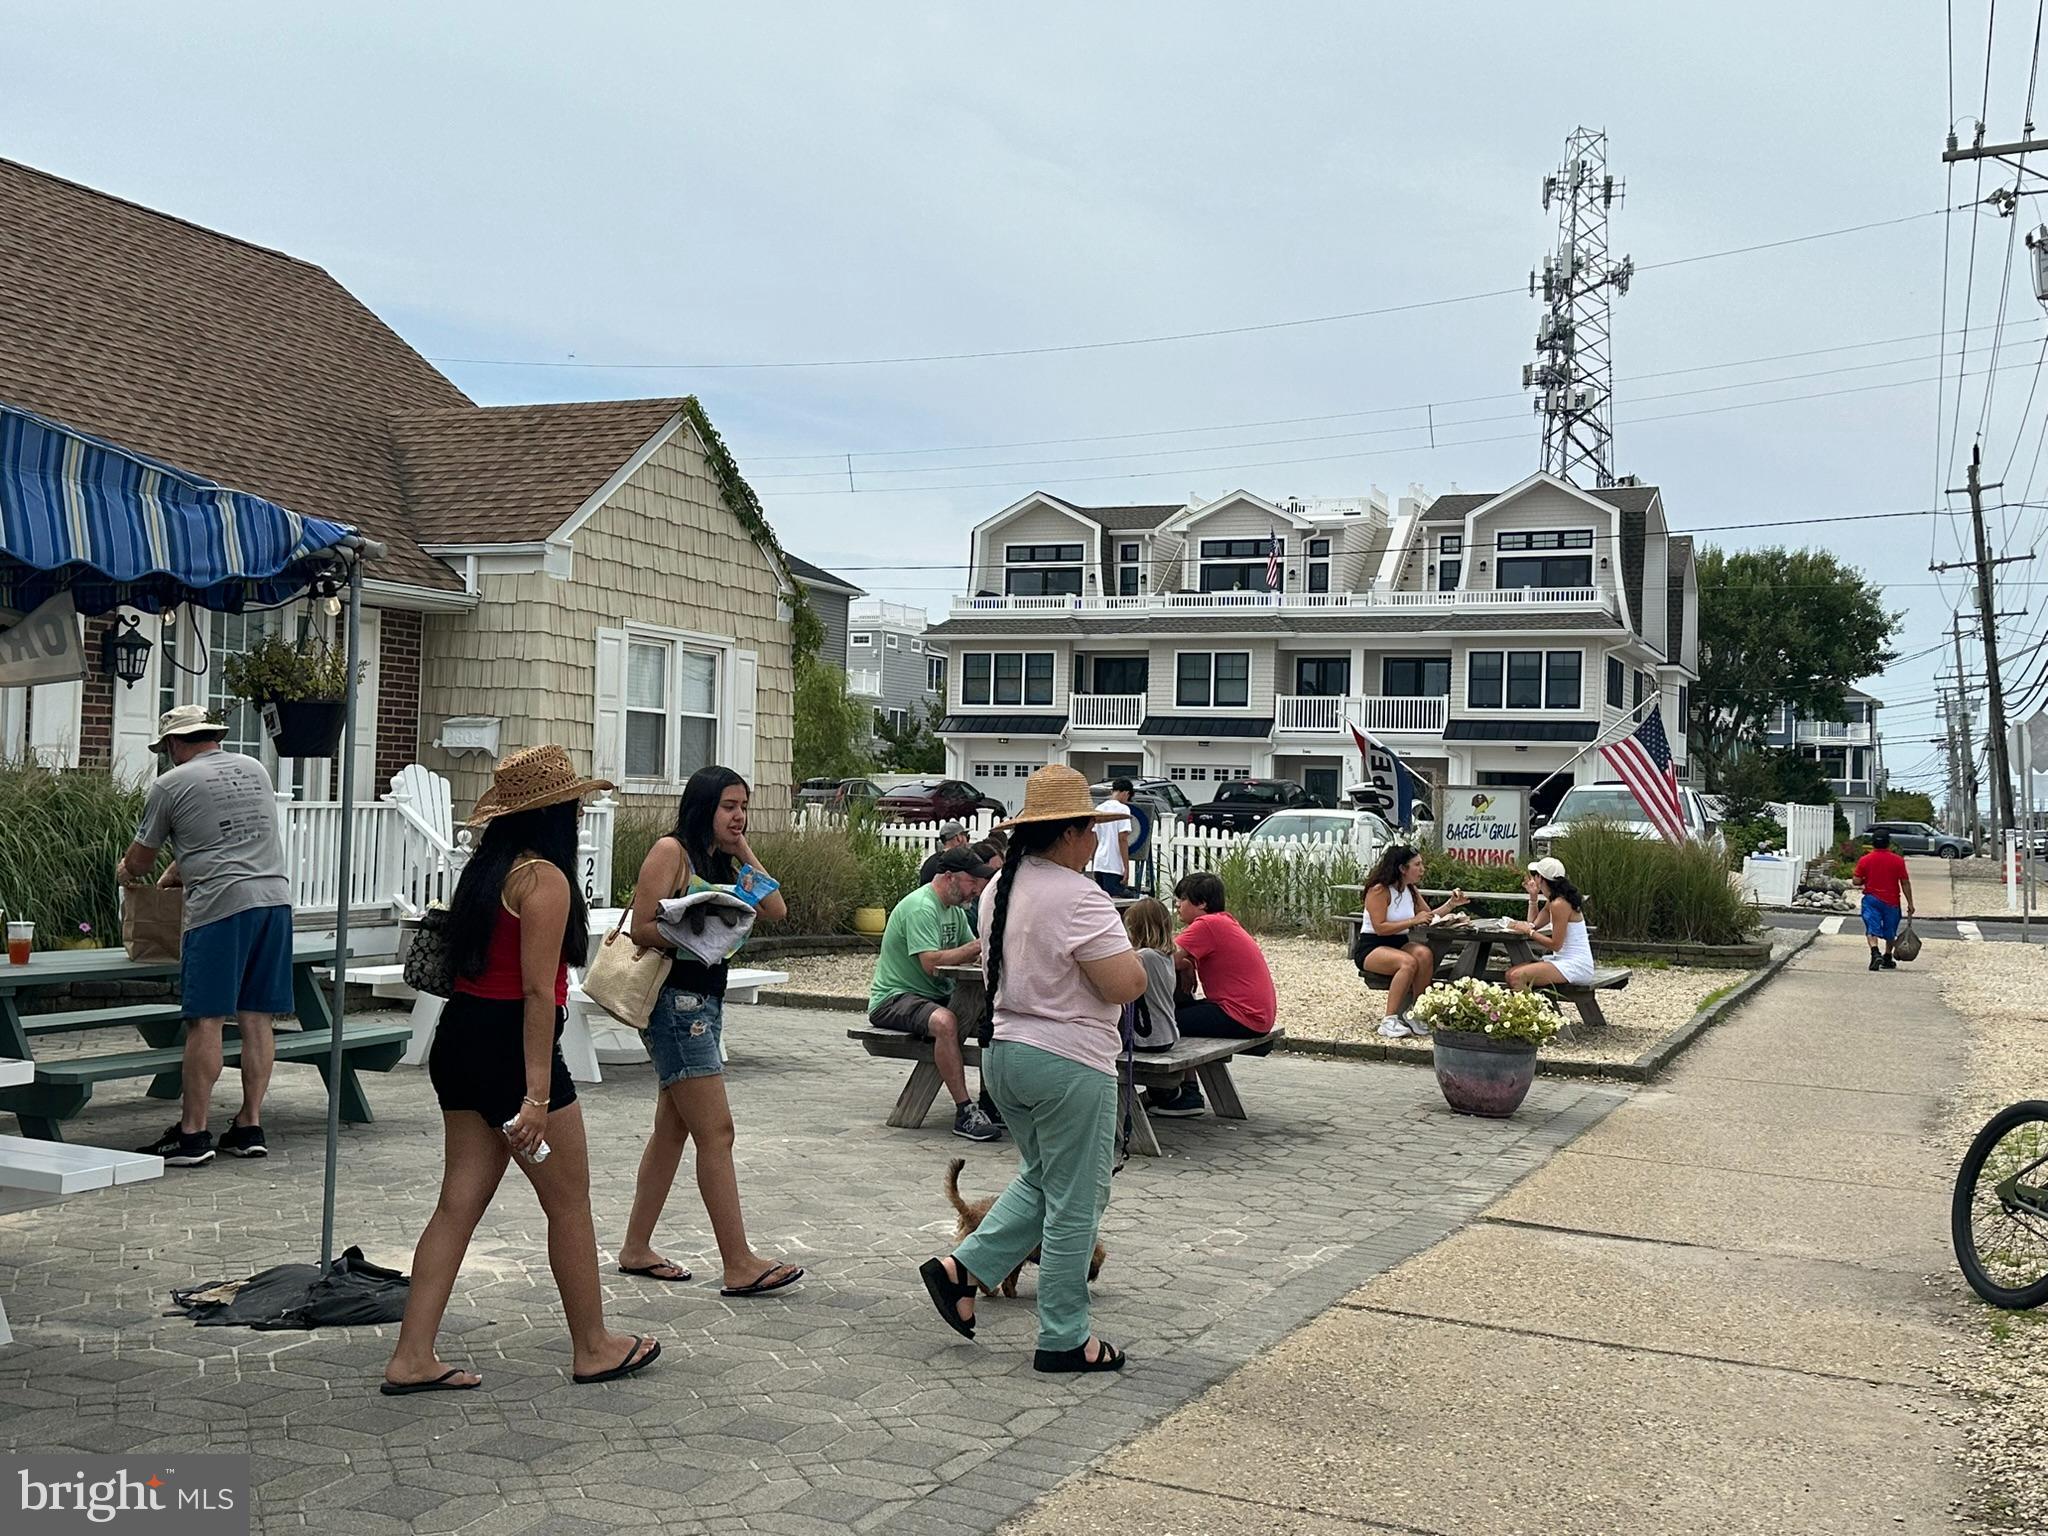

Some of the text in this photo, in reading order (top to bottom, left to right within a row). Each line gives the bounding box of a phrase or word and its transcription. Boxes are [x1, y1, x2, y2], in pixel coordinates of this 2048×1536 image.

[1446, 822, 1481, 840] BAGEL
[1489, 822, 1518, 840] GRILL
[1448, 847, 1515, 865] PARKING
